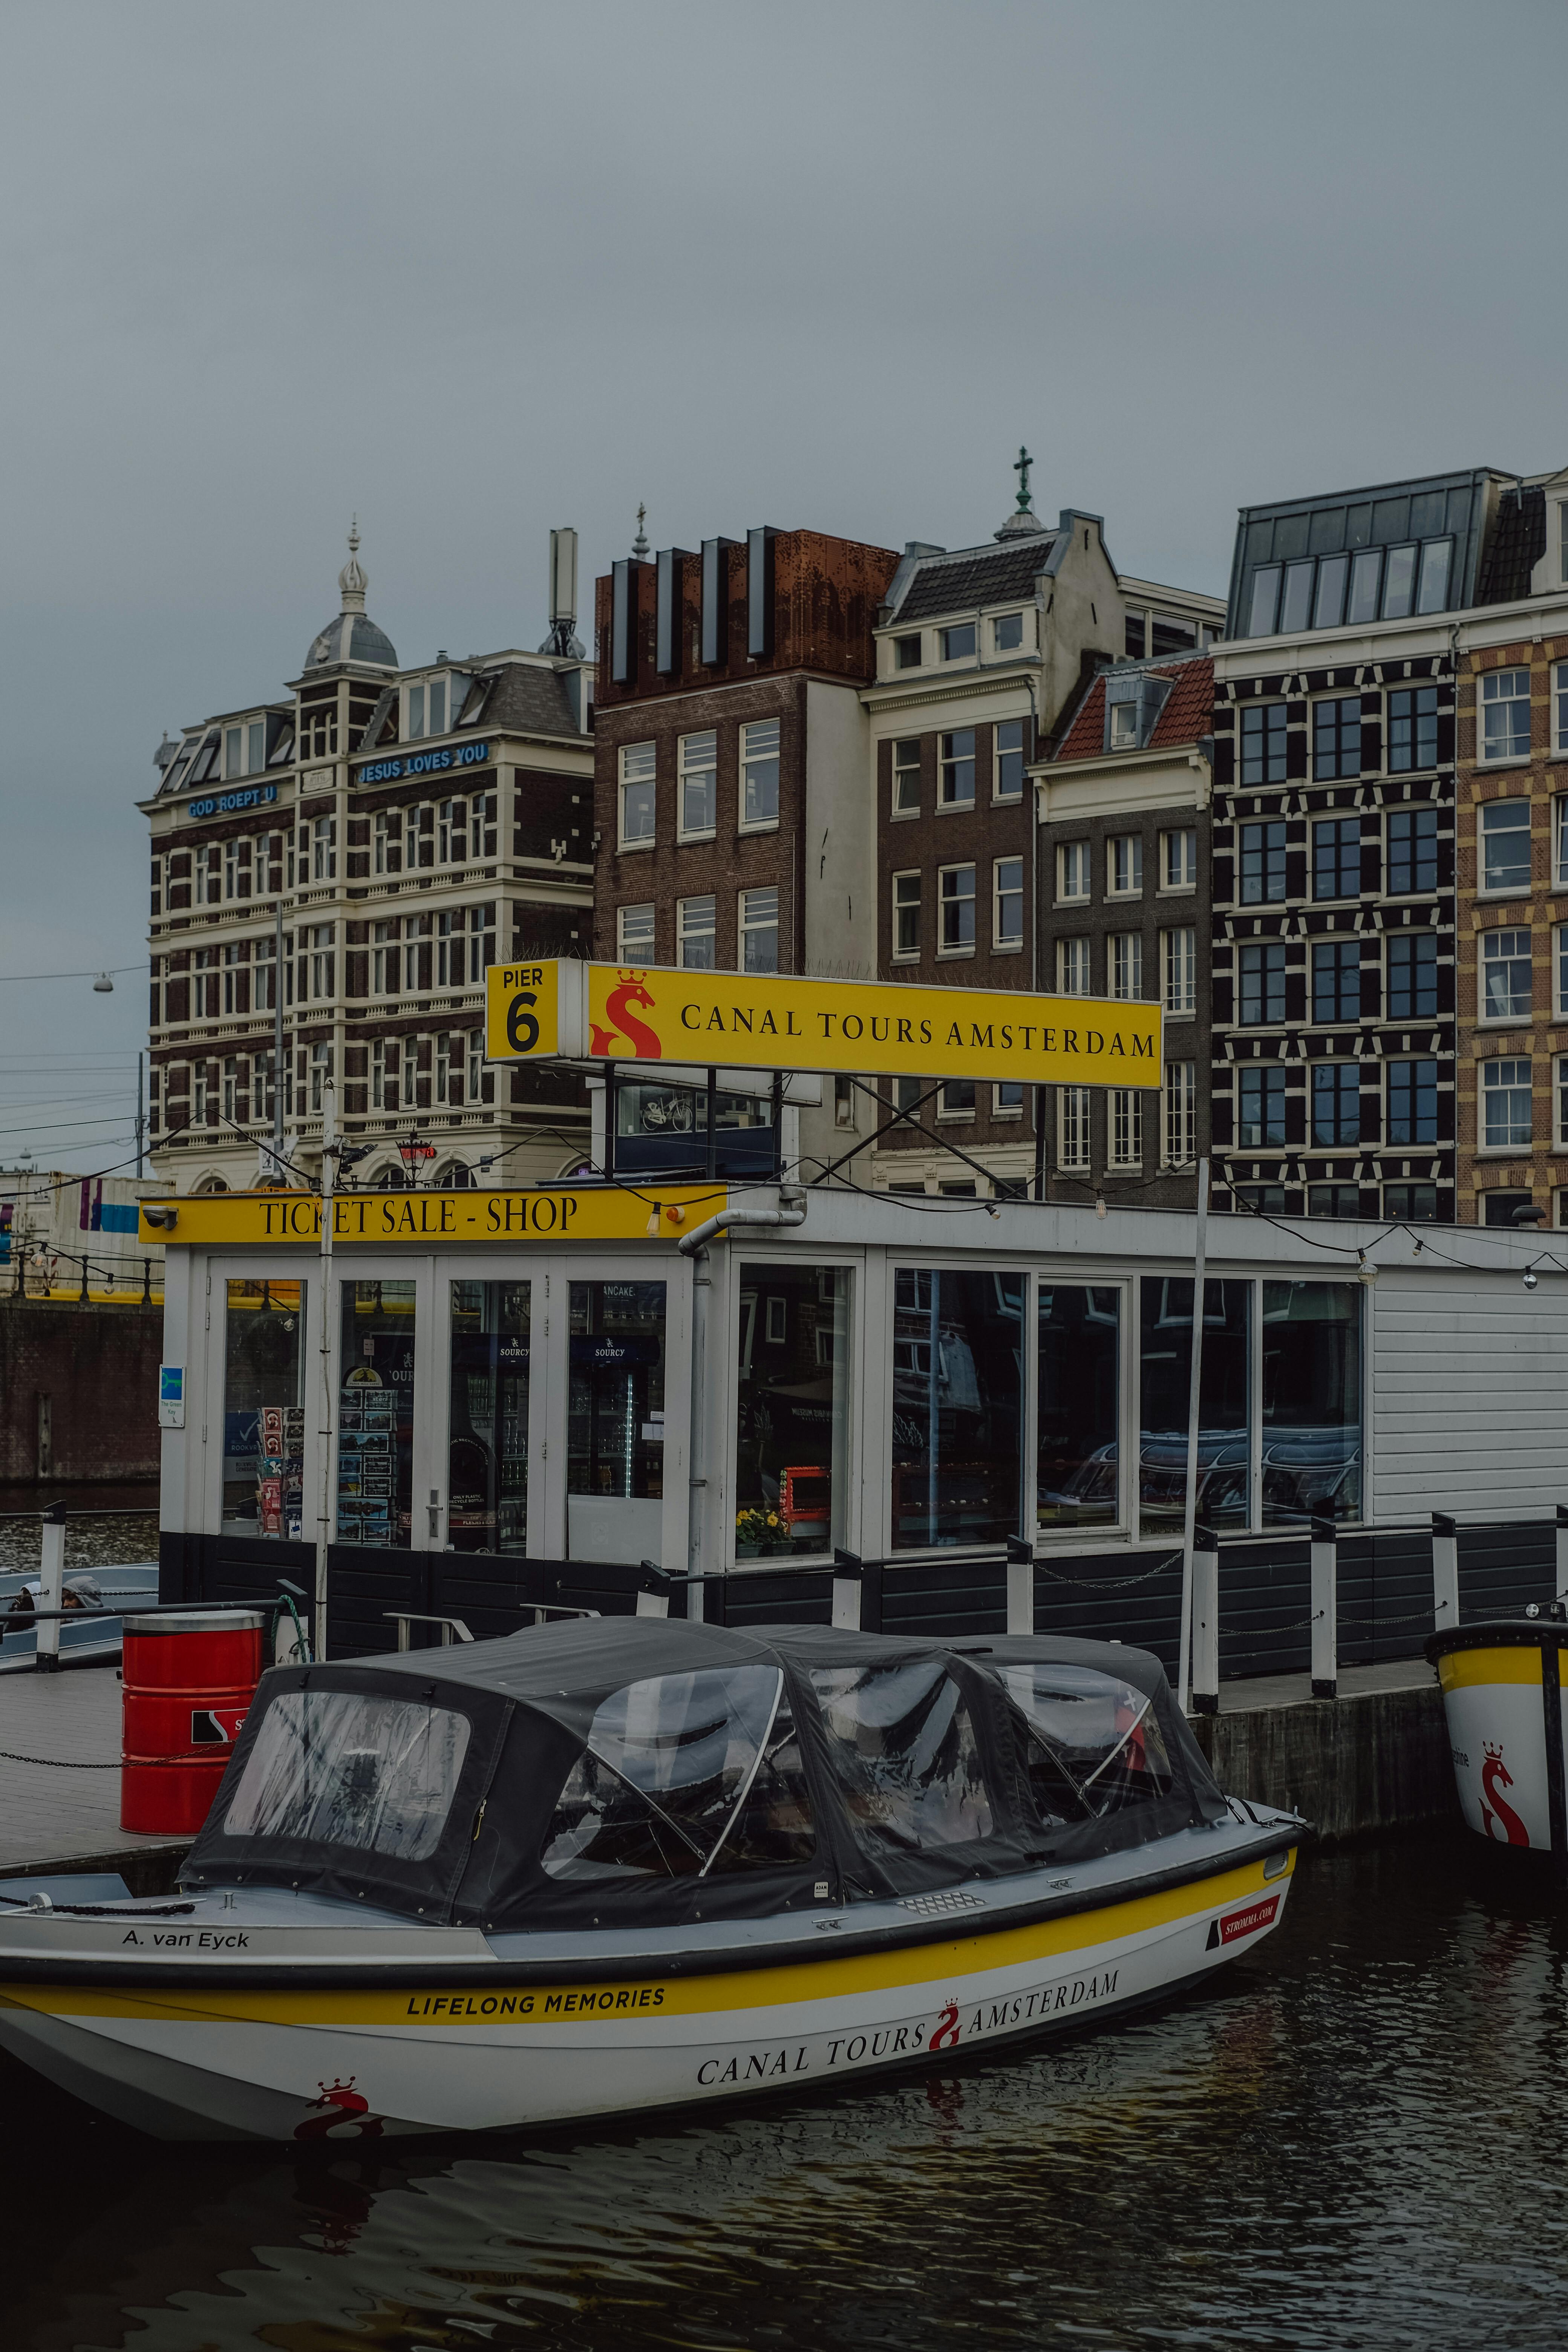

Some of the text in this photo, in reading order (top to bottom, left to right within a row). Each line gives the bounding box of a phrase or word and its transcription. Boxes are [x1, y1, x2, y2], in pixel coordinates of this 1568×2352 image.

[358, 744, 488, 784] JESUS LOVES YOU
[188, 786, 277, 819] GOD ROEPT U
[504, 968, 543, 989] PIER
[507, 992, 539, 1052] 6
[681, 1004, 1155, 1058] CANAL TOURS AMSTERDAM
[382, 1200, 456, 1233] SALE
[487, 1197, 577, 1232] SHOP
[603, 1286, 635, 1296] ANCAKE.
[458, 1438, 479, 1447] RECYCLE
[1225, 1905, 1274, 1935] STROMMA.COM
[122, 1930, 250, 1950] A. van Eyck
[407, 1988, 665, 2015] LIFELONG MEMORIES
[697, 1970, 1119, 2086] CANAL TOURS AMSTERDAM
